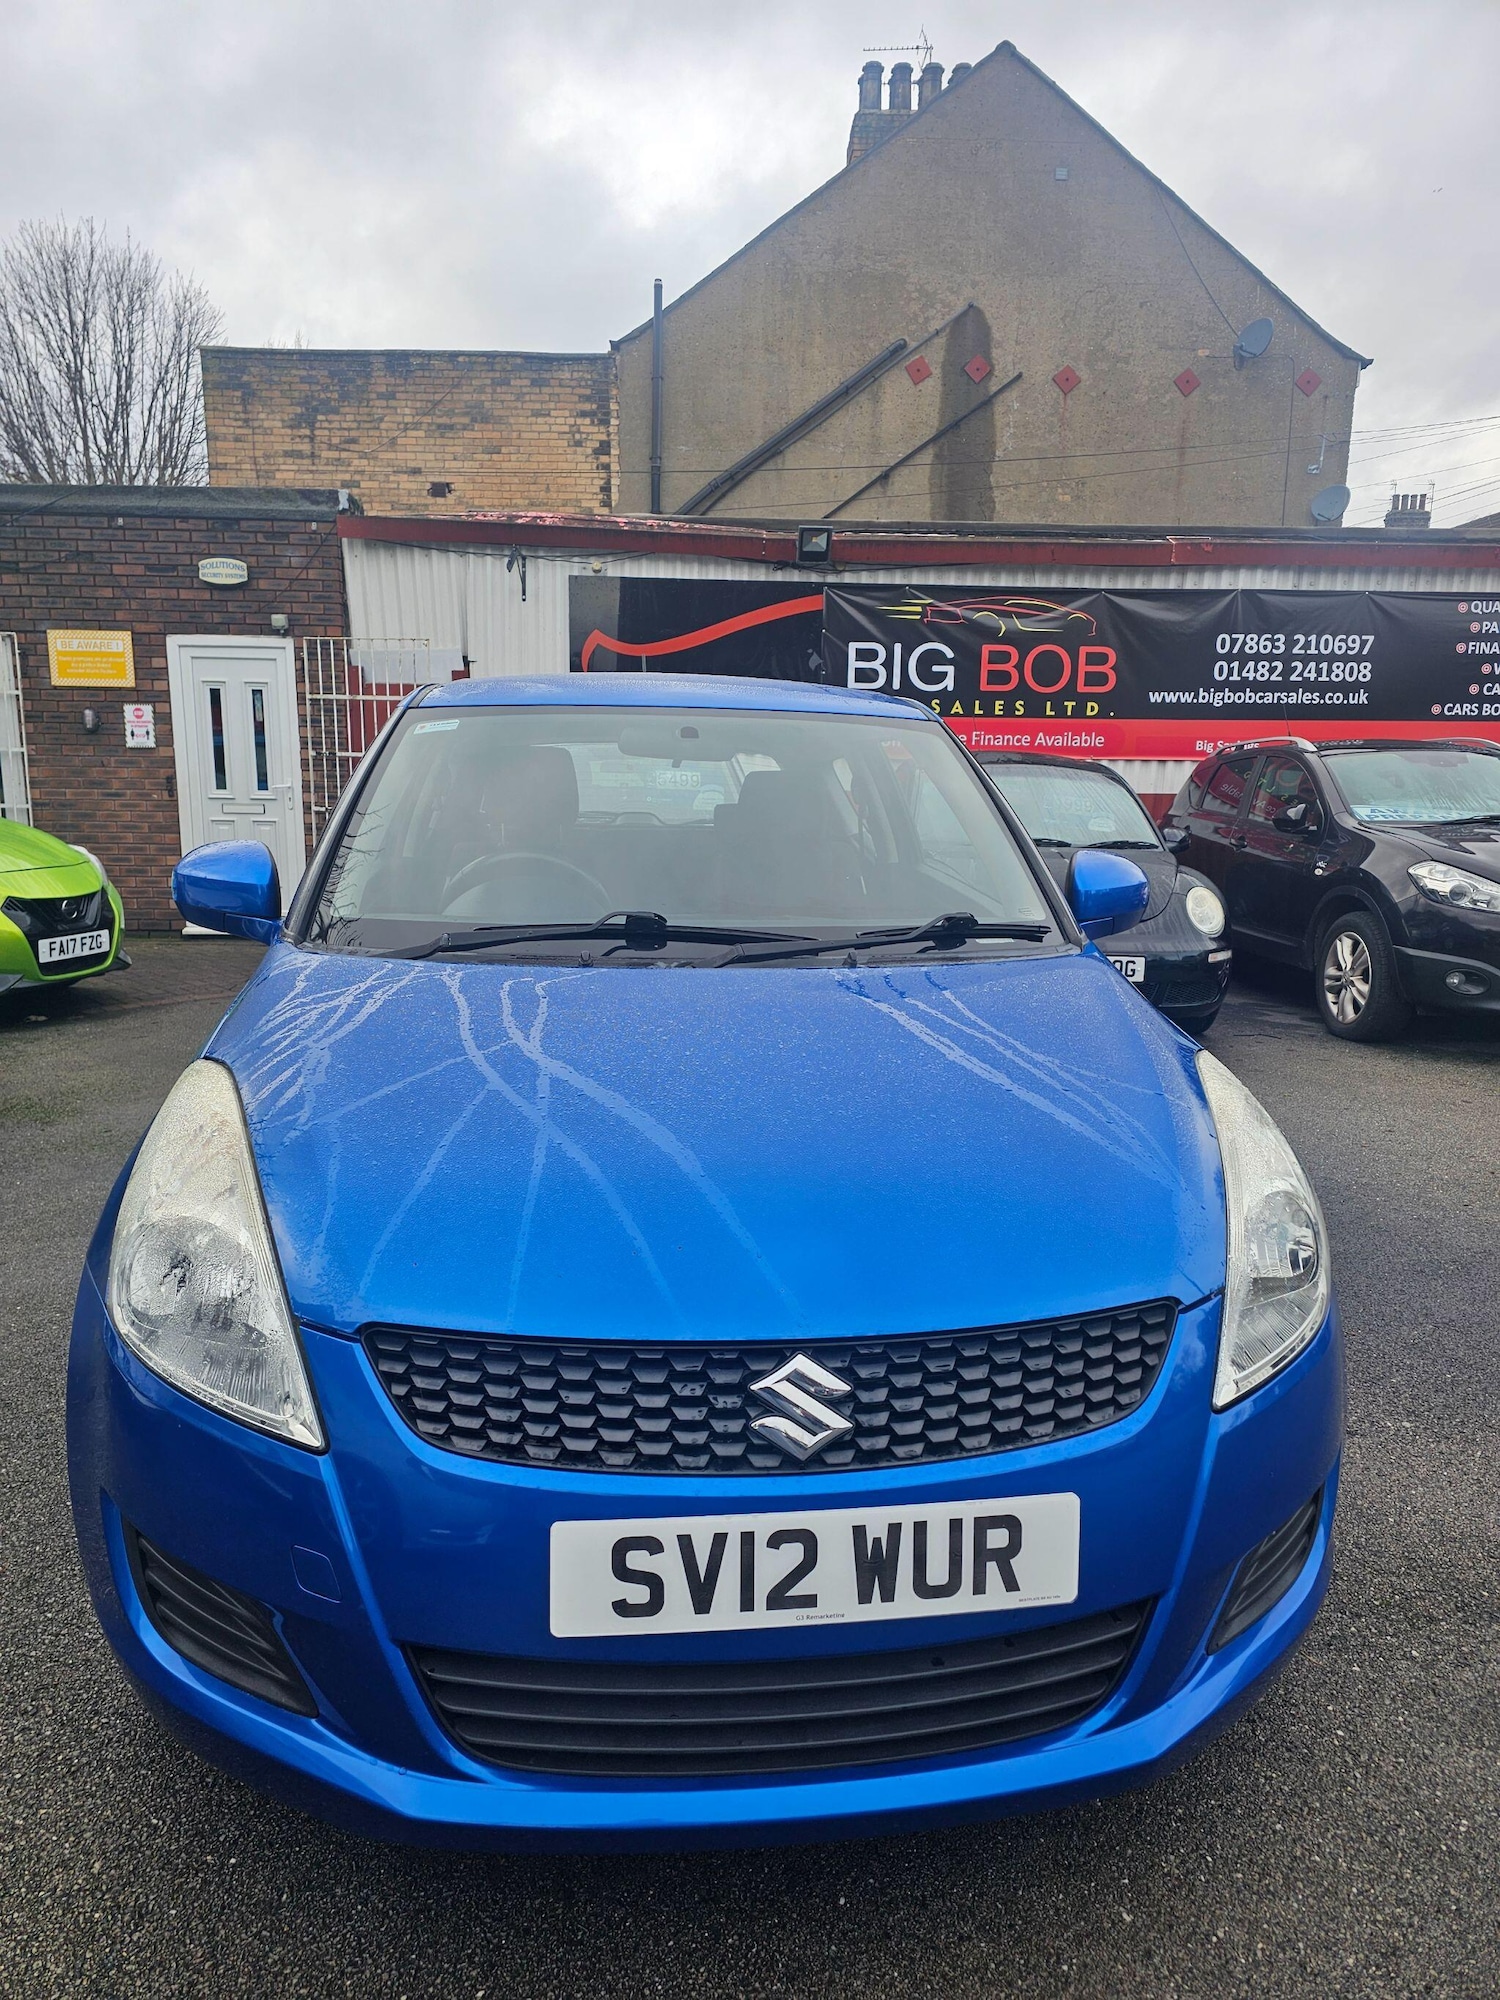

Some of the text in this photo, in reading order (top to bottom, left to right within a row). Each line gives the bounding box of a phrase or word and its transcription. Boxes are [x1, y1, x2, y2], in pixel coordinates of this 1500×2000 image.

[200, 561, 246, 572] SOLUTIONS
[61, 640, 74, 649] BE
[76, 640, 112, 650] AWARE
[1215, 633, 1375, 655] 07863 210697
[847, 641, 1117, 693] BIG BOB
[1213, 660, 1372, 682] 01482 241808
[1149, 687, 1369, 707] www.bigbobcarsales.co.uk
[931, 698, 1115, 717] SALES LTD.
[1443, 703, 1479, 716] CARS
[971, 731, 1031, 747] Finance
[1034, 732, 1105, 747] Available
[1195, 740, 1214, 753] Big
[49, 934, 102, 958] FA17 FZG
[611, 1514, 1022, 1618] SV12 WUR
